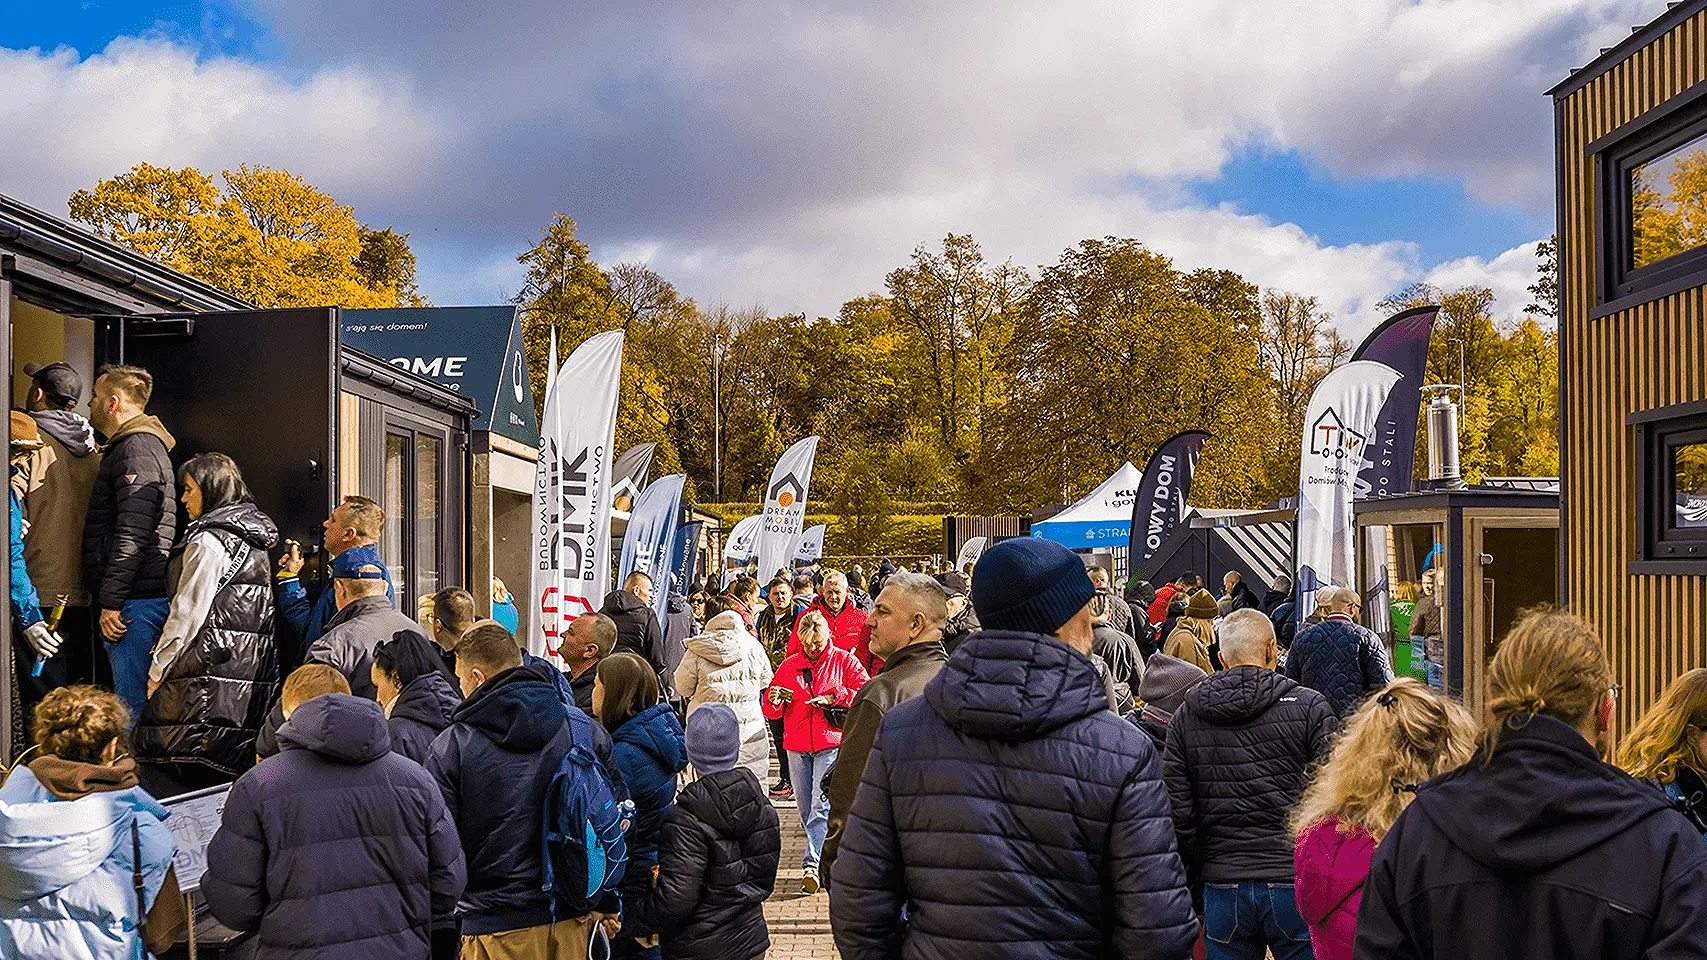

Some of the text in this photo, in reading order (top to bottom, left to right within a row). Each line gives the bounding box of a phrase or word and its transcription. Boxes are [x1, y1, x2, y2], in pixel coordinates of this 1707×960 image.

[386, 322, 428, 331] domem!
[383, 356, 467, 377] OME
[1378, 421, 1397, 496] DO STALI
[1153, 454, 1177, 500] DOM
[583, 445, 604, 581] BUDOWNICTWO
[767, 506, 800, 517] DREAM
[764, 524, 798, 535] HOUSE
